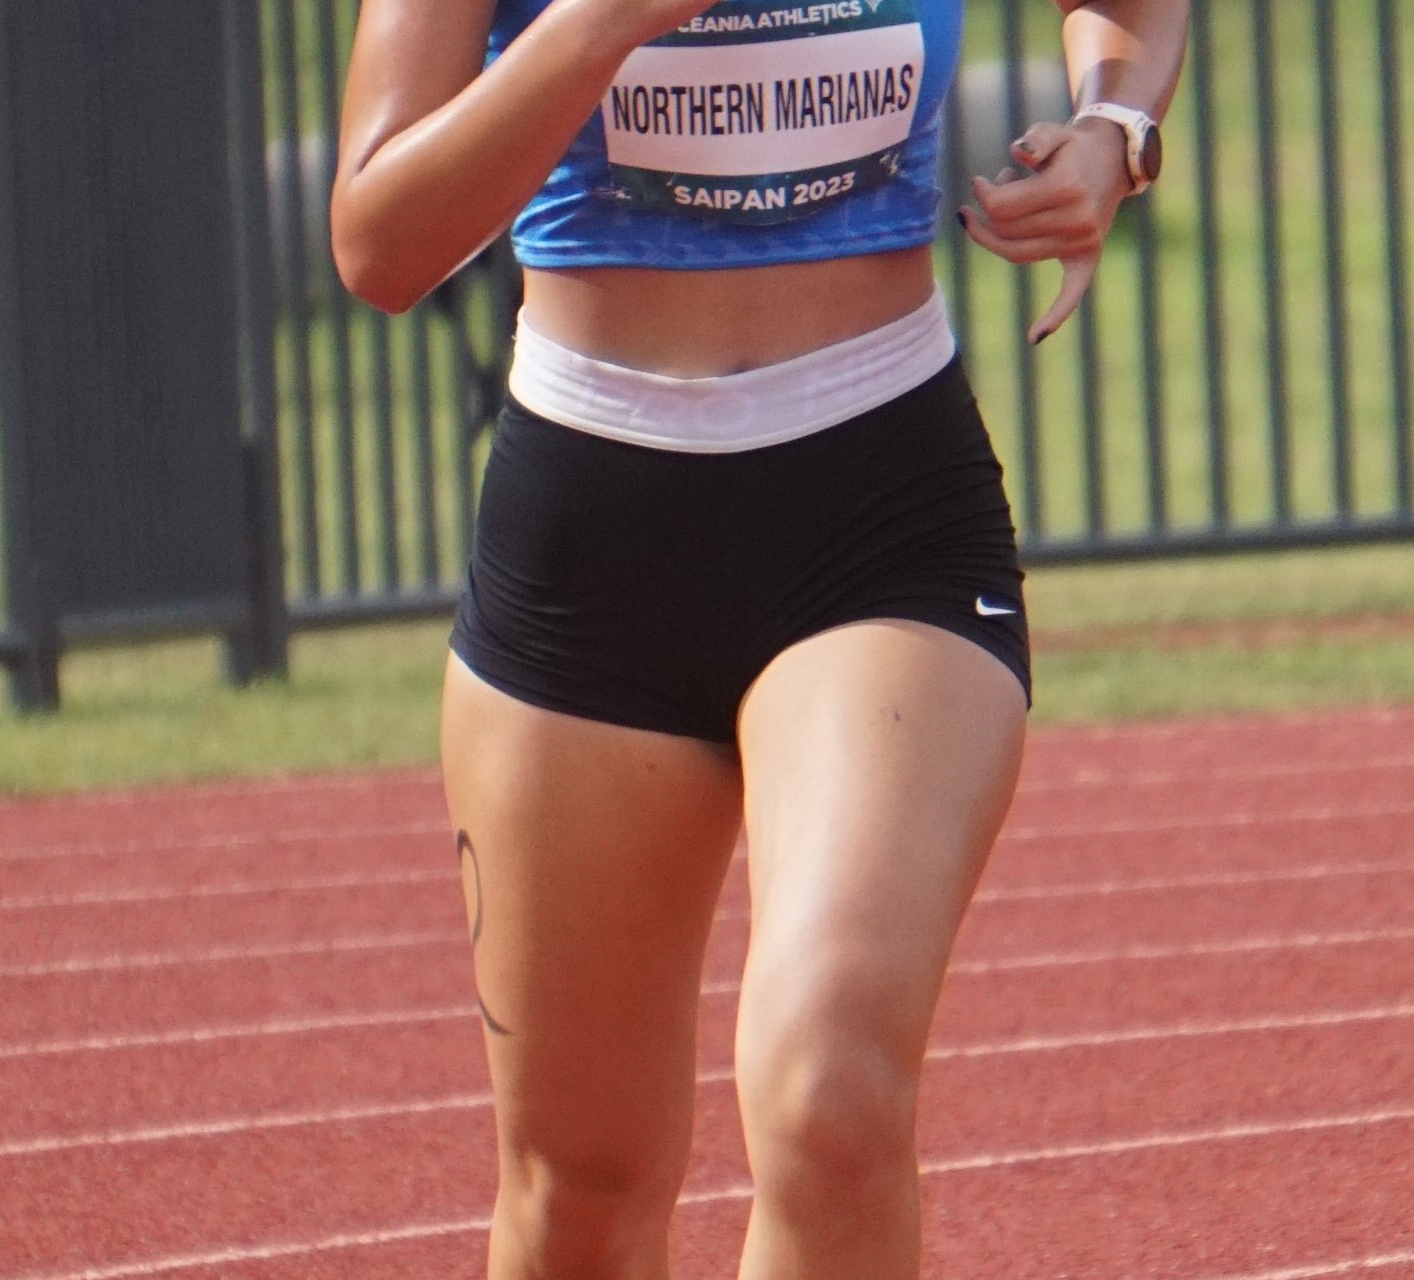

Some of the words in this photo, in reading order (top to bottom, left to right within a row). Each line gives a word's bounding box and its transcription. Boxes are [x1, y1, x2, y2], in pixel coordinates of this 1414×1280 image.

[757, 0, 863, 28] ATHLETICS
[611, 81, 765, 136] NORTHERN
[775, 63, 914, 132] MARIANAS
[674, 185, 786, 211] SAIPAN
[793, 171, 856, 205] 2023
